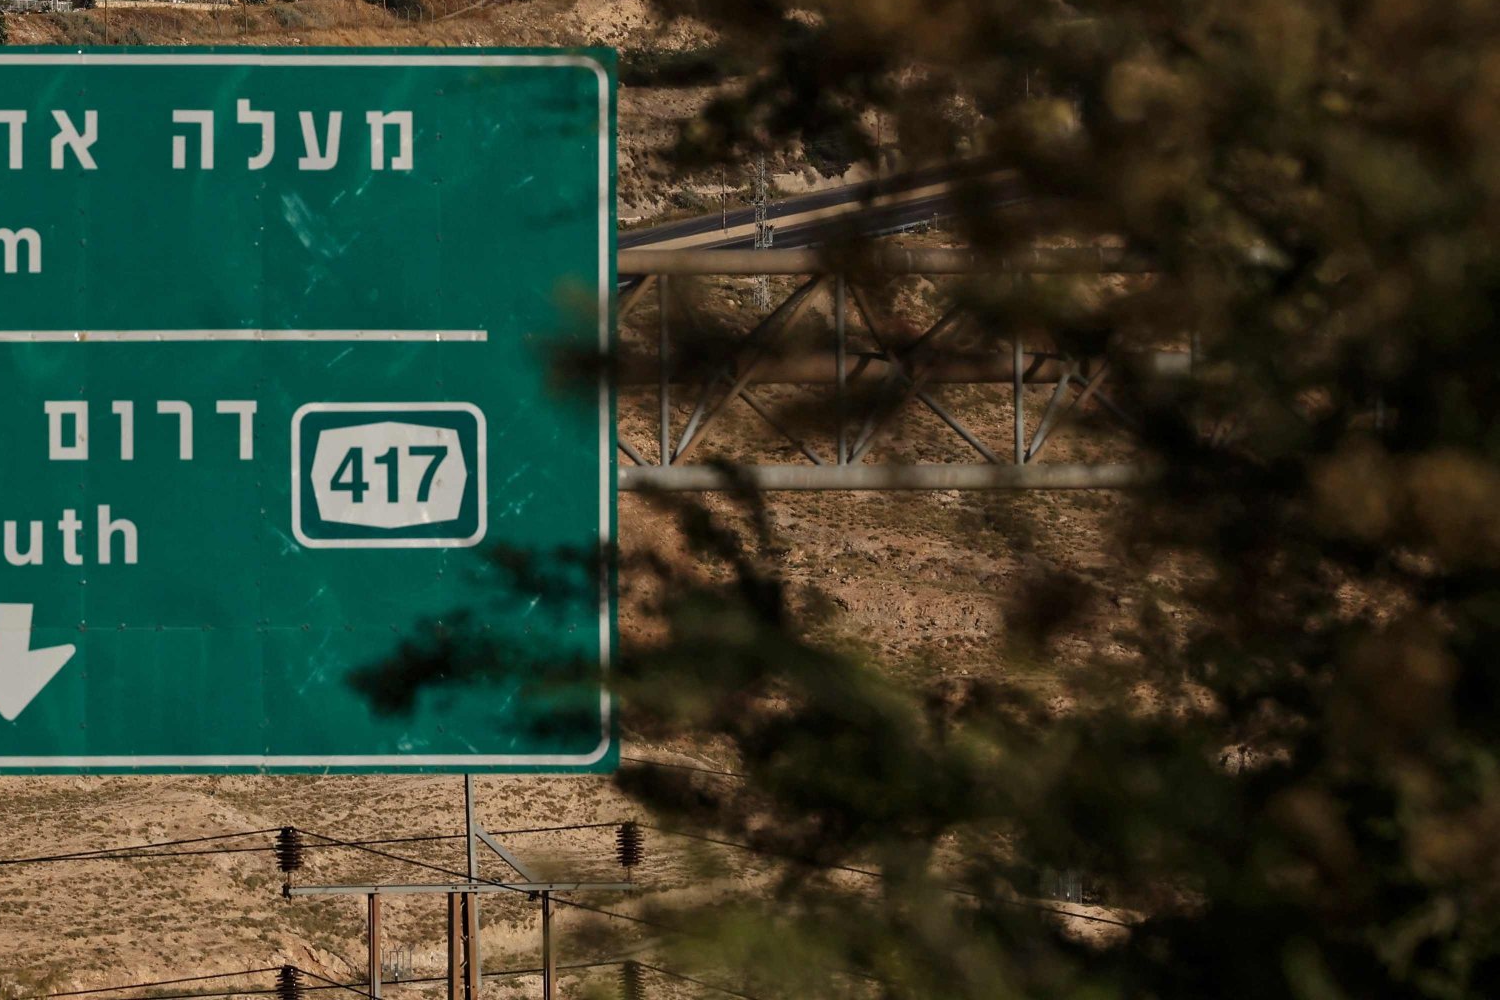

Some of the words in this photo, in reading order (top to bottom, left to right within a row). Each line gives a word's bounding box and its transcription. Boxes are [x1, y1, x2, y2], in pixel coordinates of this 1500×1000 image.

[172, 98, 414, 171] מעלה
[43, 399, 258, 461] דרום
[328, 444, 450, 504] 417
